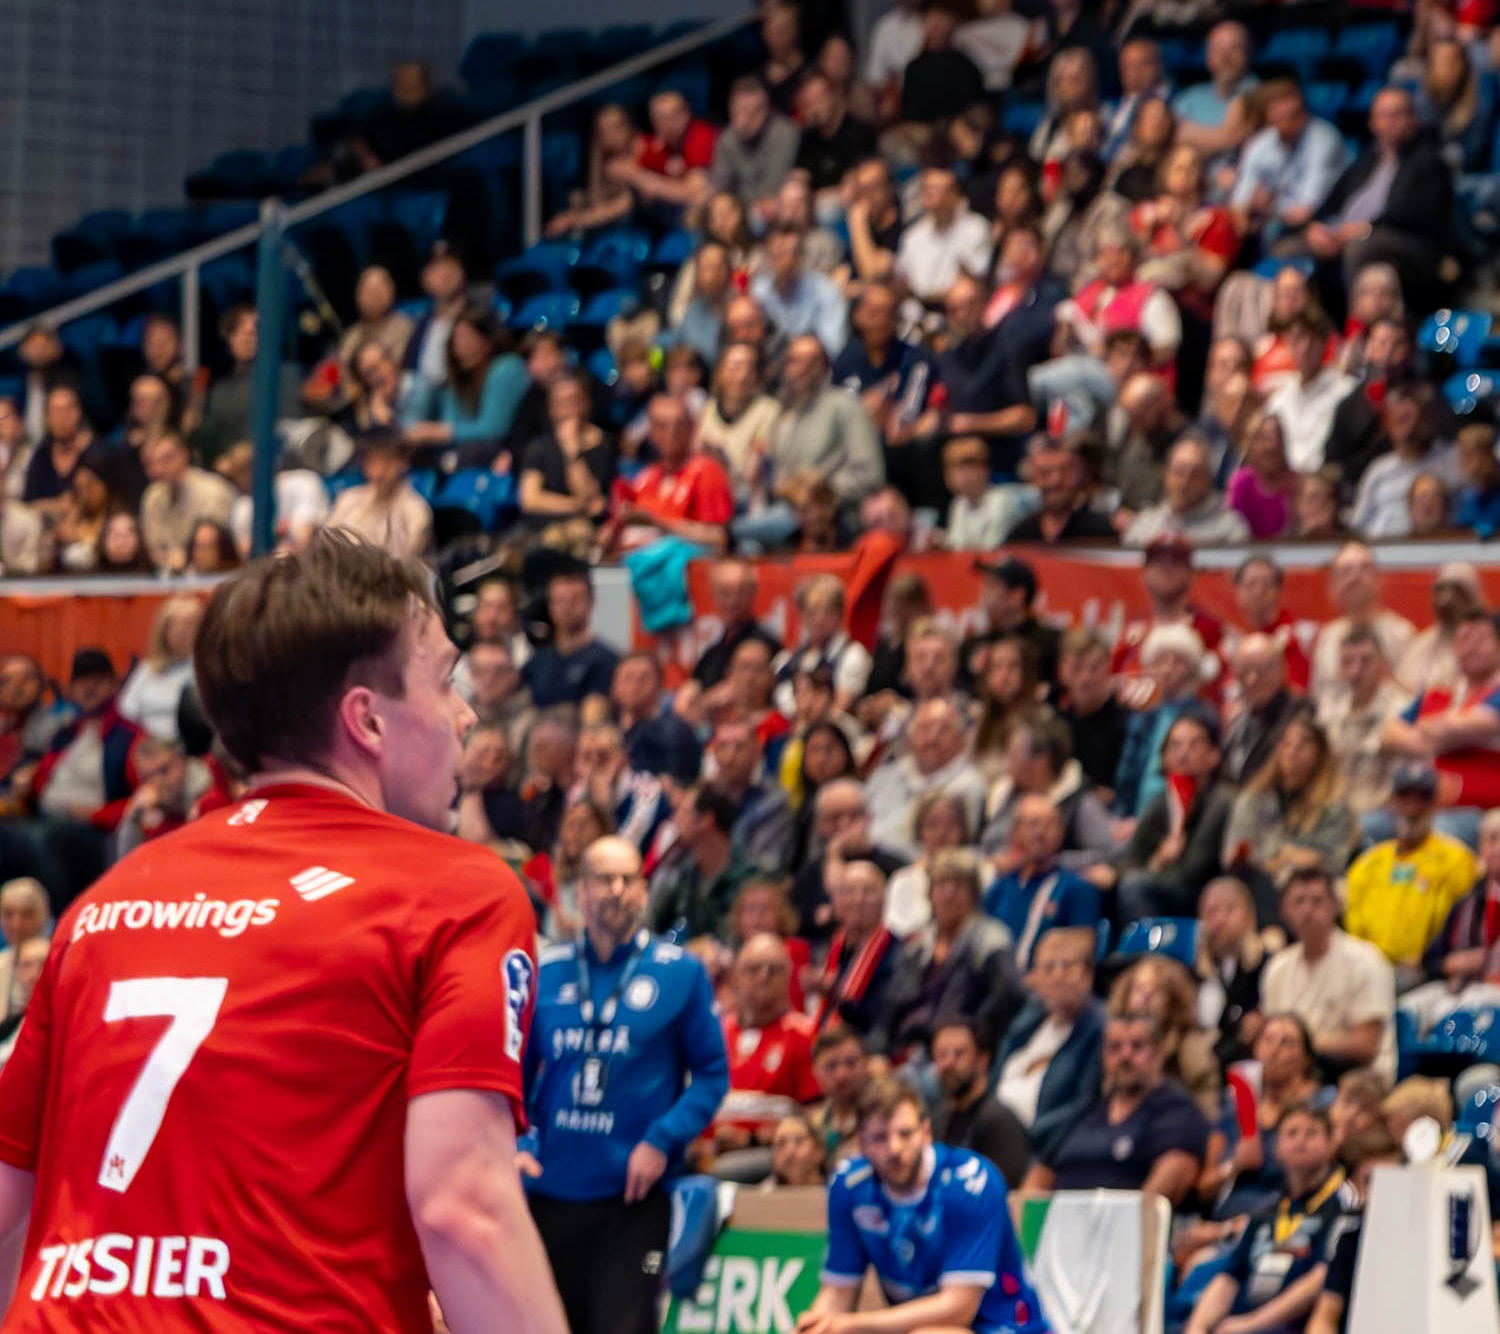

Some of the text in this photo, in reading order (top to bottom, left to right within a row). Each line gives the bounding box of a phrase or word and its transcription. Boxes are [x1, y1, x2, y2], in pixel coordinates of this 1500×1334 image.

[72, 892, 280, 944] Eurowings
[97, 977, 229, 1193] 7
[31, 1233, 230, 1301] TISSIER
